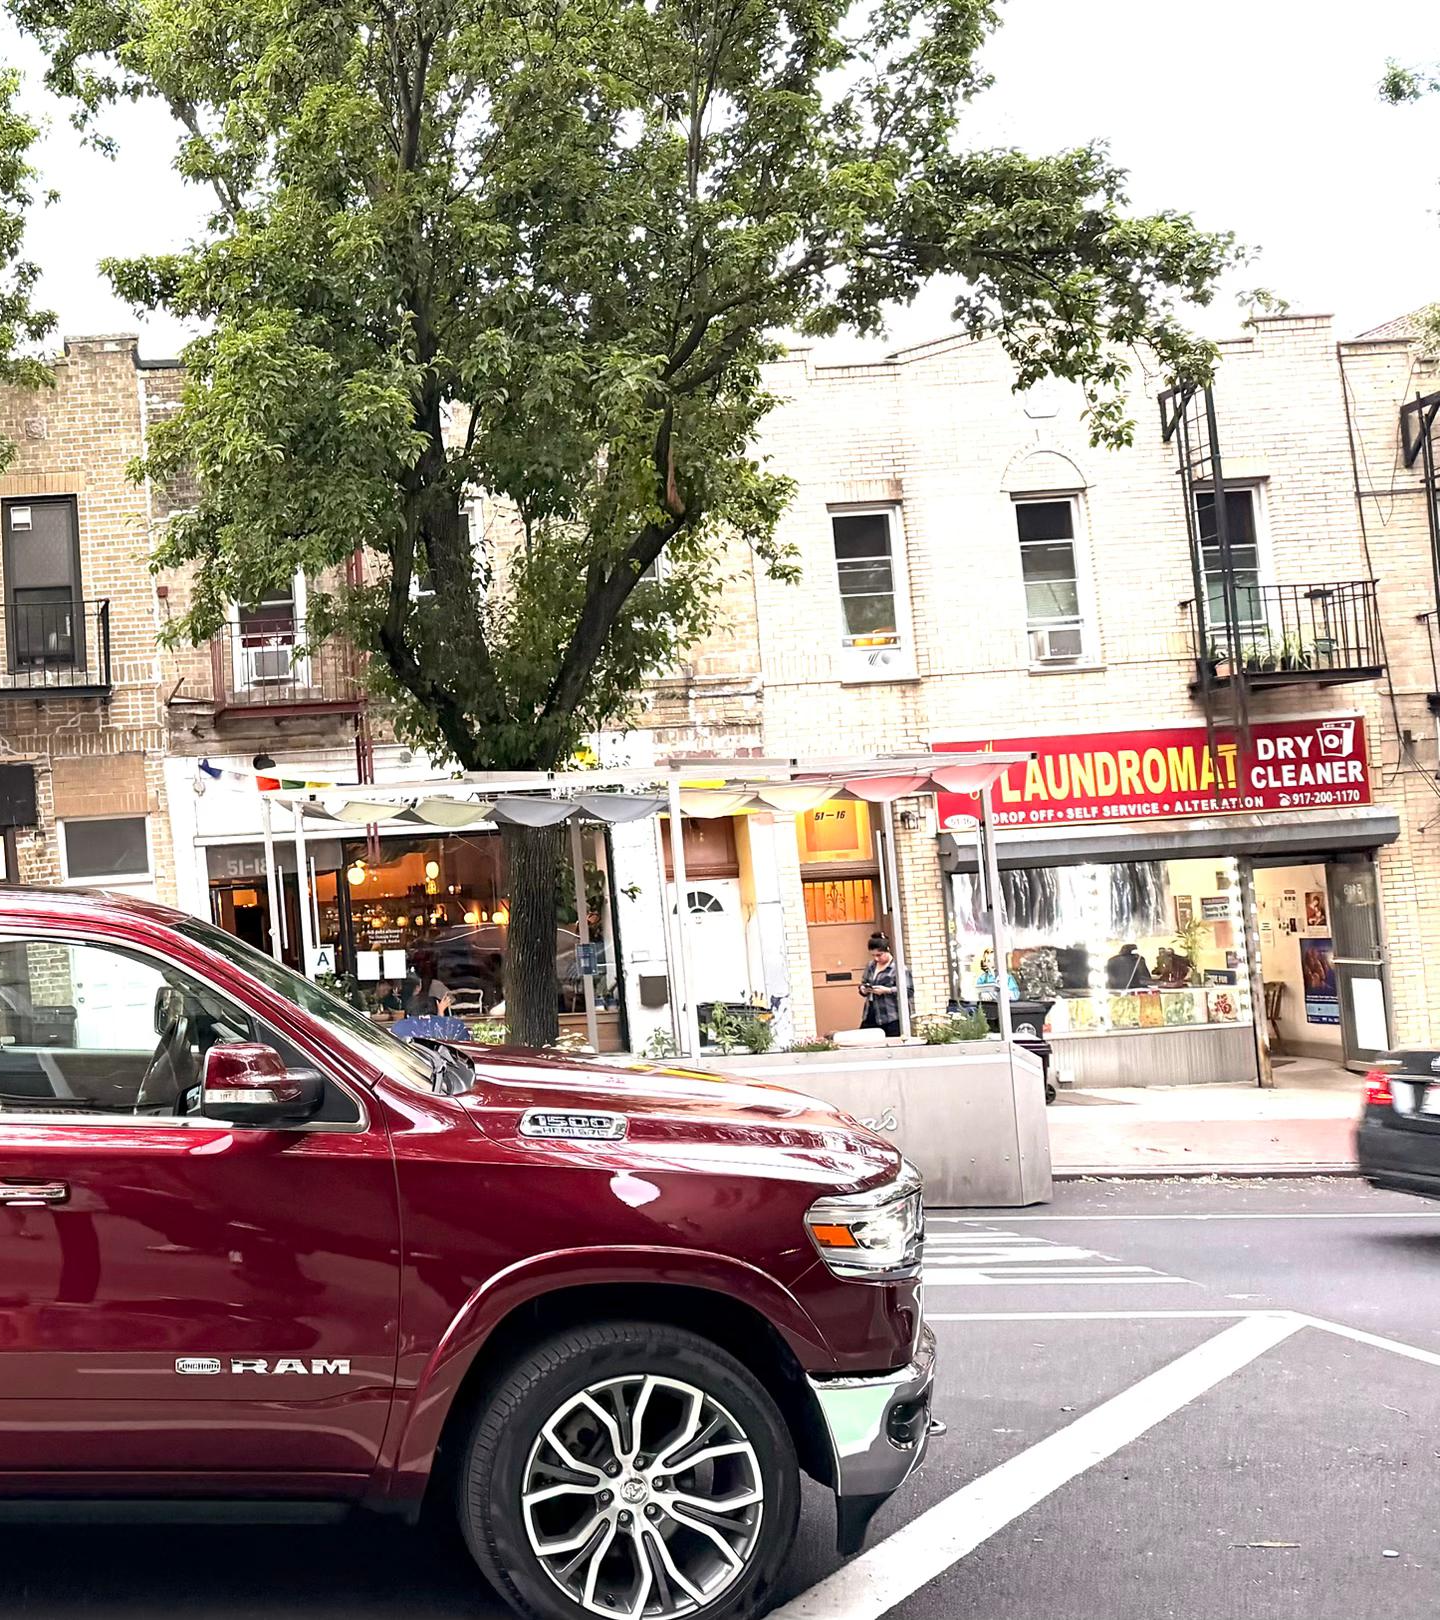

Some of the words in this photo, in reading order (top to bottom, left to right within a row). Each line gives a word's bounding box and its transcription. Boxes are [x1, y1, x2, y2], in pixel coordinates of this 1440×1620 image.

[1256, 736, 1313, 760] DRY
[999, 744, 1237, 803] LAUNDROMAT
[1251, 760, 1364, 788] CLEANER
[1292, 789, 1360, 805] 917-200-1170
[992, 811, 1026, 824] DROP
[1030, 809, 1054, 822] OFF
[1066, 806, 1098, 819] SELF
[1102, 802, 1160, 817] SERVICE
[1174, 795, 1264, 813] ALTERATION
[317, 951, 330, 966] A
[534, 1115, 613, 1129] 1500
[231, 1359, 350, 1374] RAM
